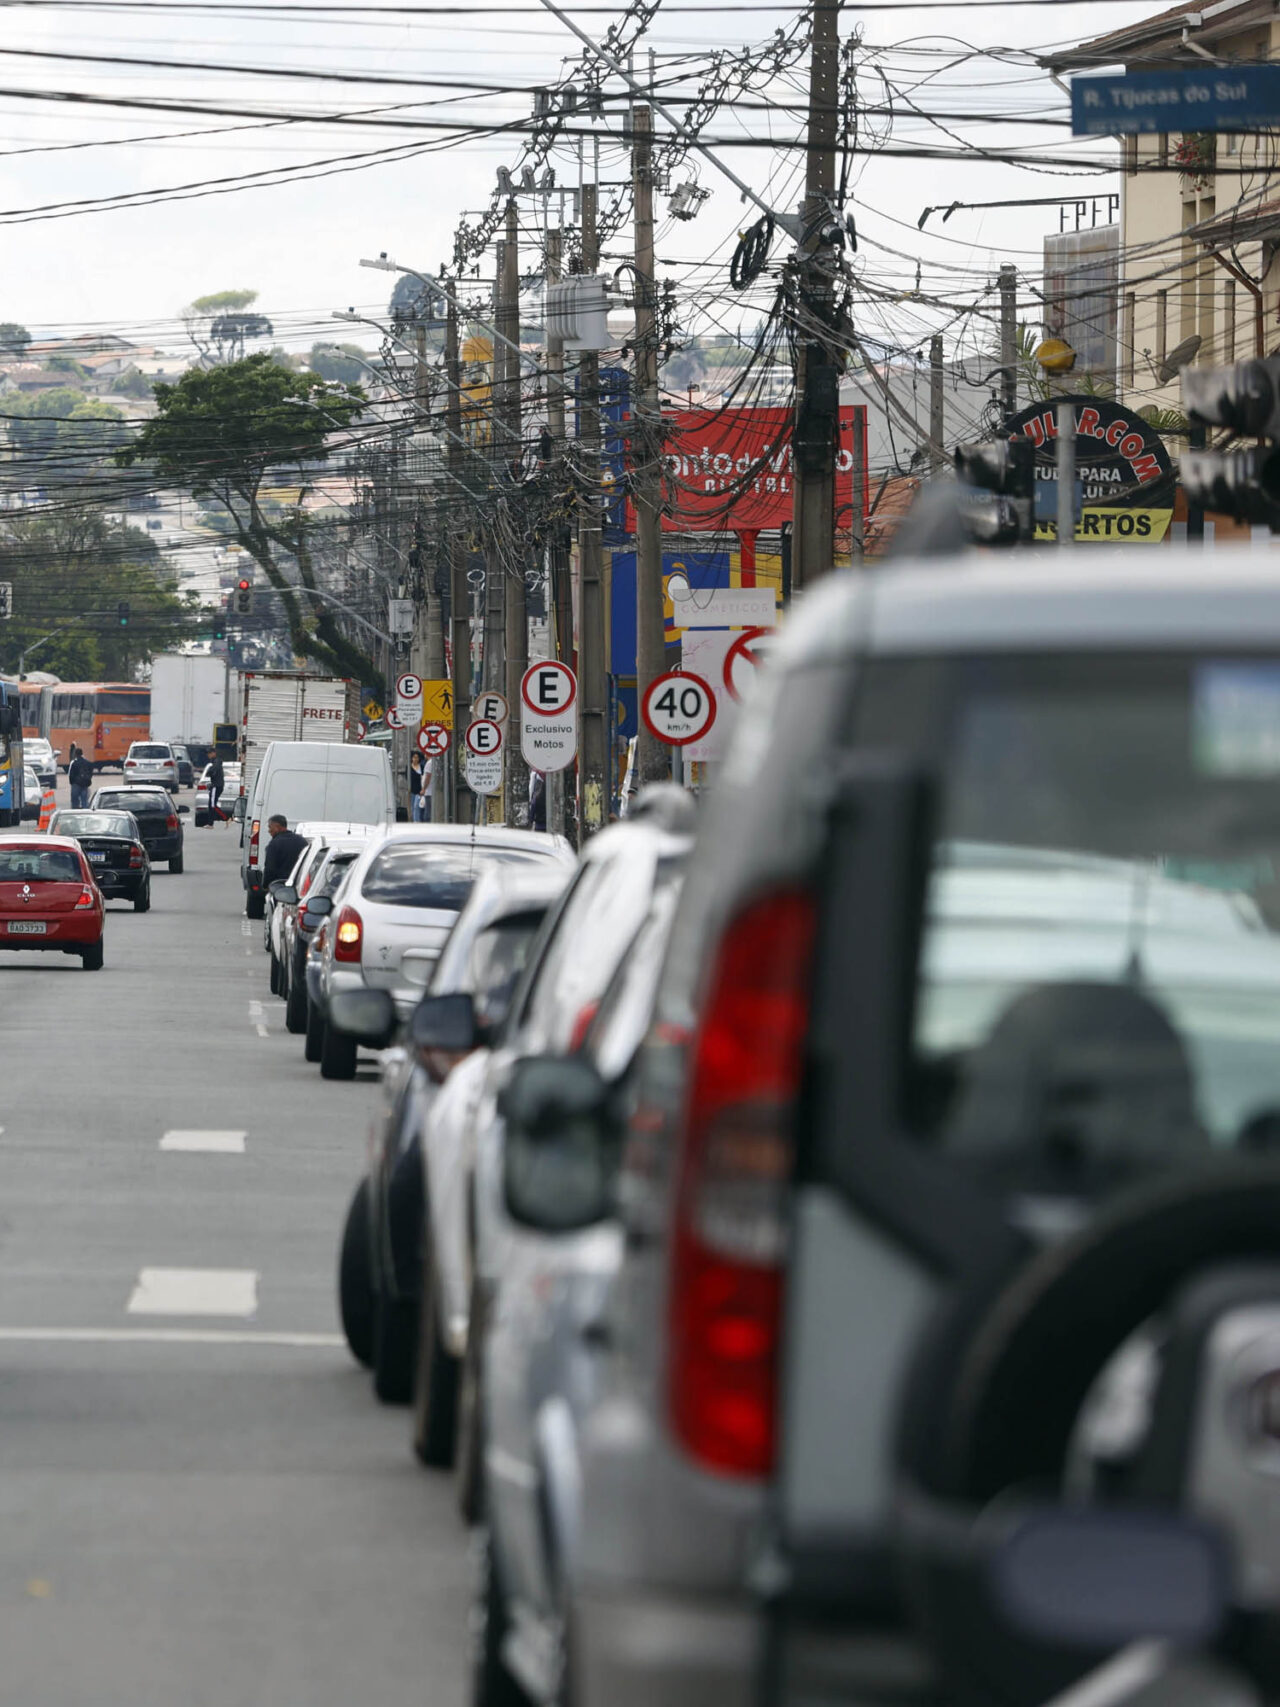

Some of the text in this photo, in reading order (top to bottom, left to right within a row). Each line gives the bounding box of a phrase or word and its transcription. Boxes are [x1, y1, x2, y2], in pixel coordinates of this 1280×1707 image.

[1110, 86, 1180, 110] Tijucas
[1184, 85, 1210, 103] do
[1214, 82, 1248, 101] Sul
[662, 446, 732, 476] onto
[1081, 467, 1122, 481] PARA
[404, 679, 414, 694] E
[539, 671, 559, 704] E
[484, 698, 499, 720] E
[654, 687, 702, 719] 40
[303, 707, 343, 720] FRETE
[525, 724, 573, 734] Exclusivo
[667, 722, 692, 732] km/h
[477, 727, 490, 748] E
[534, 740, 565, 749] Motos
